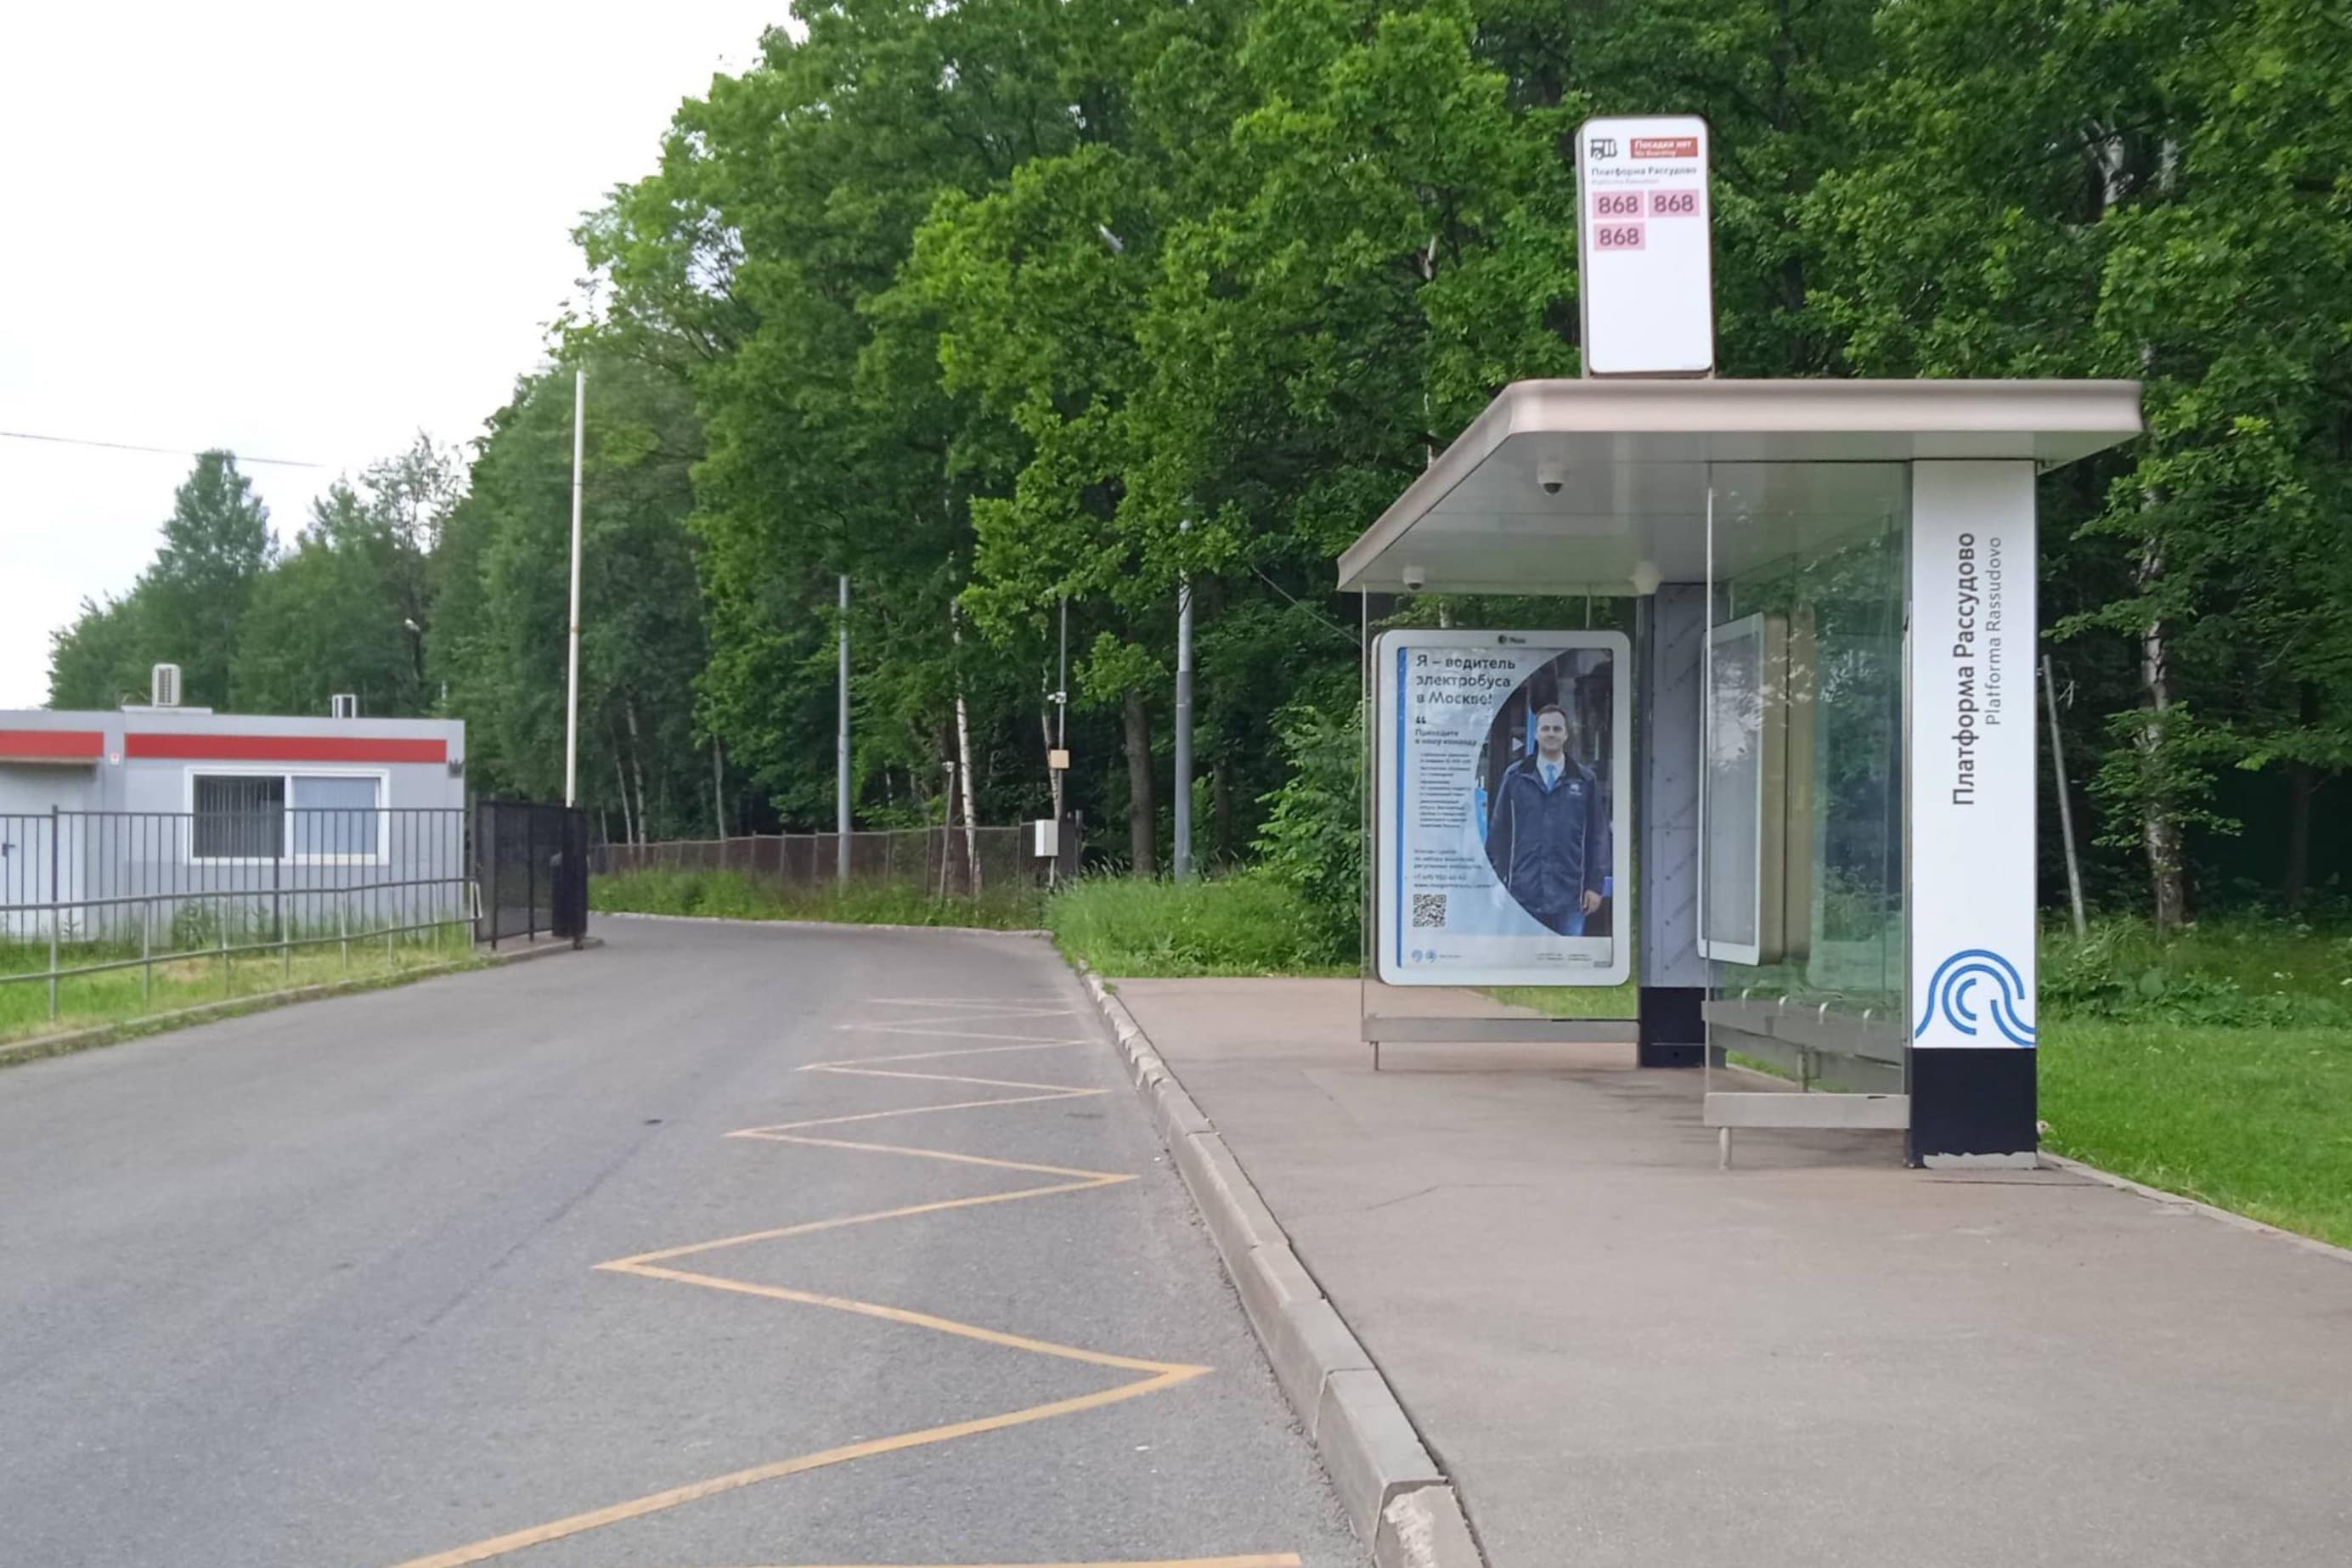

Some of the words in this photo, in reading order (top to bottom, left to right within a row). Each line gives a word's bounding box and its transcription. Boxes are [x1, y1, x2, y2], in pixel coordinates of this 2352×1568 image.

[1591, 166, 1646, 177] Платформа
[1648, 166, 1697, 177] Рассудово
[1598, 196, 1639, 214] 868
[1654, 195, 1694, 212] 868
[1599, 228, 1639, 246] 868
[1984, 536, 2002, 633] Rassudovo
[1952, 532, 1980, 659] Рассудово
[1417, 654, 1428, 667] Я
[1446, 657, 1516, 670] водитель
[1416, 673, 1511, 690] электробуса
[1984, 636, 2002, 725] Platforma
[1417, 693, 1425, 704] в
[1429, 691, 1493, 705] Москве!
[1951, 665, 1980, 806] Платформа
